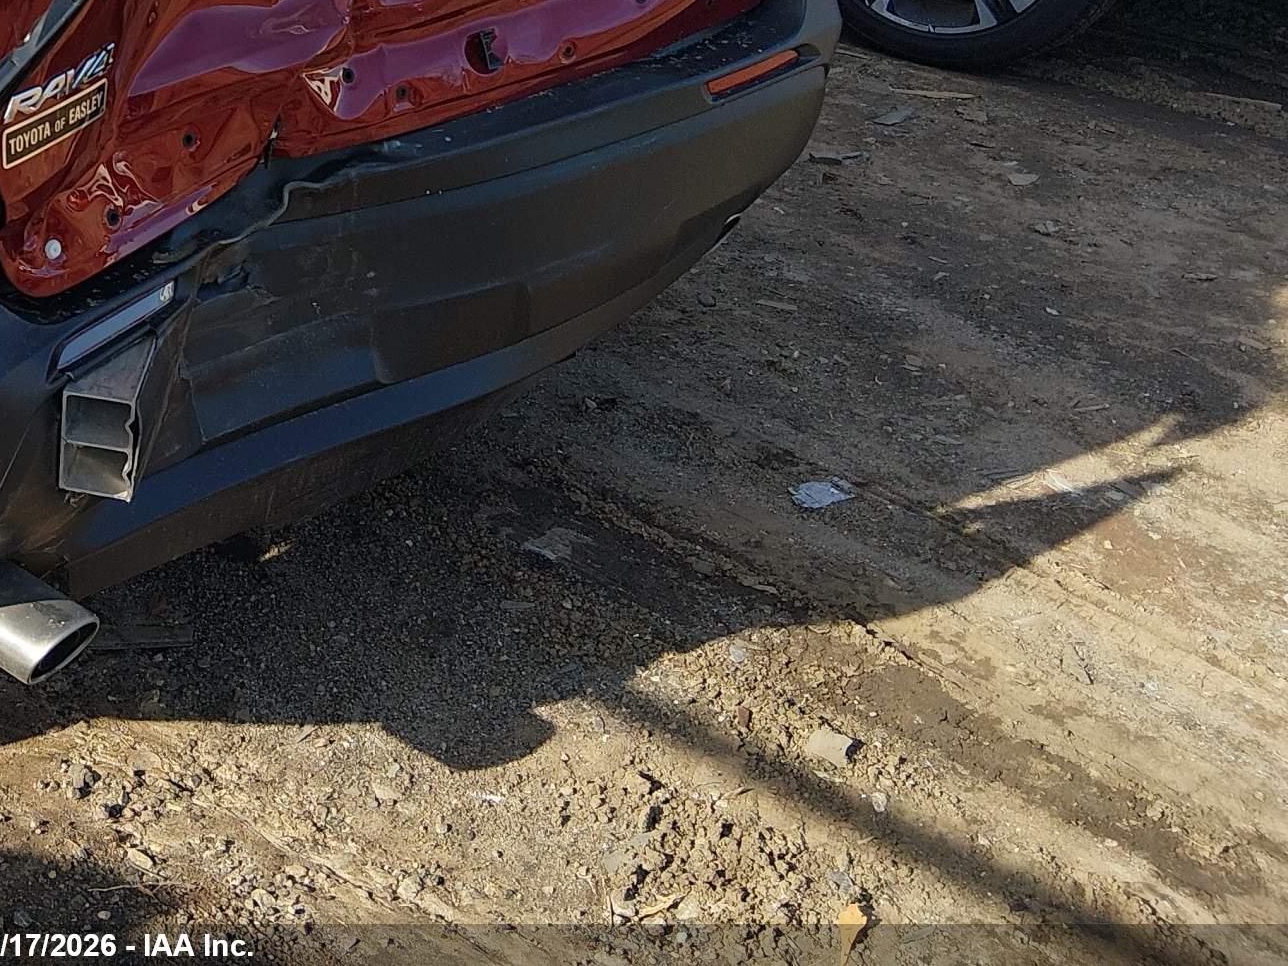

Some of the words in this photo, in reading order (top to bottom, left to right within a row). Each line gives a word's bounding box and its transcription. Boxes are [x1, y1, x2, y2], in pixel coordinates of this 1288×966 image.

[3, 42, 115, 124] RAV4
[8, 123, 51, 155] TOYOTA
[54, 119, 66, 134] OF
[68, 91, 103, 124] EASLEY
